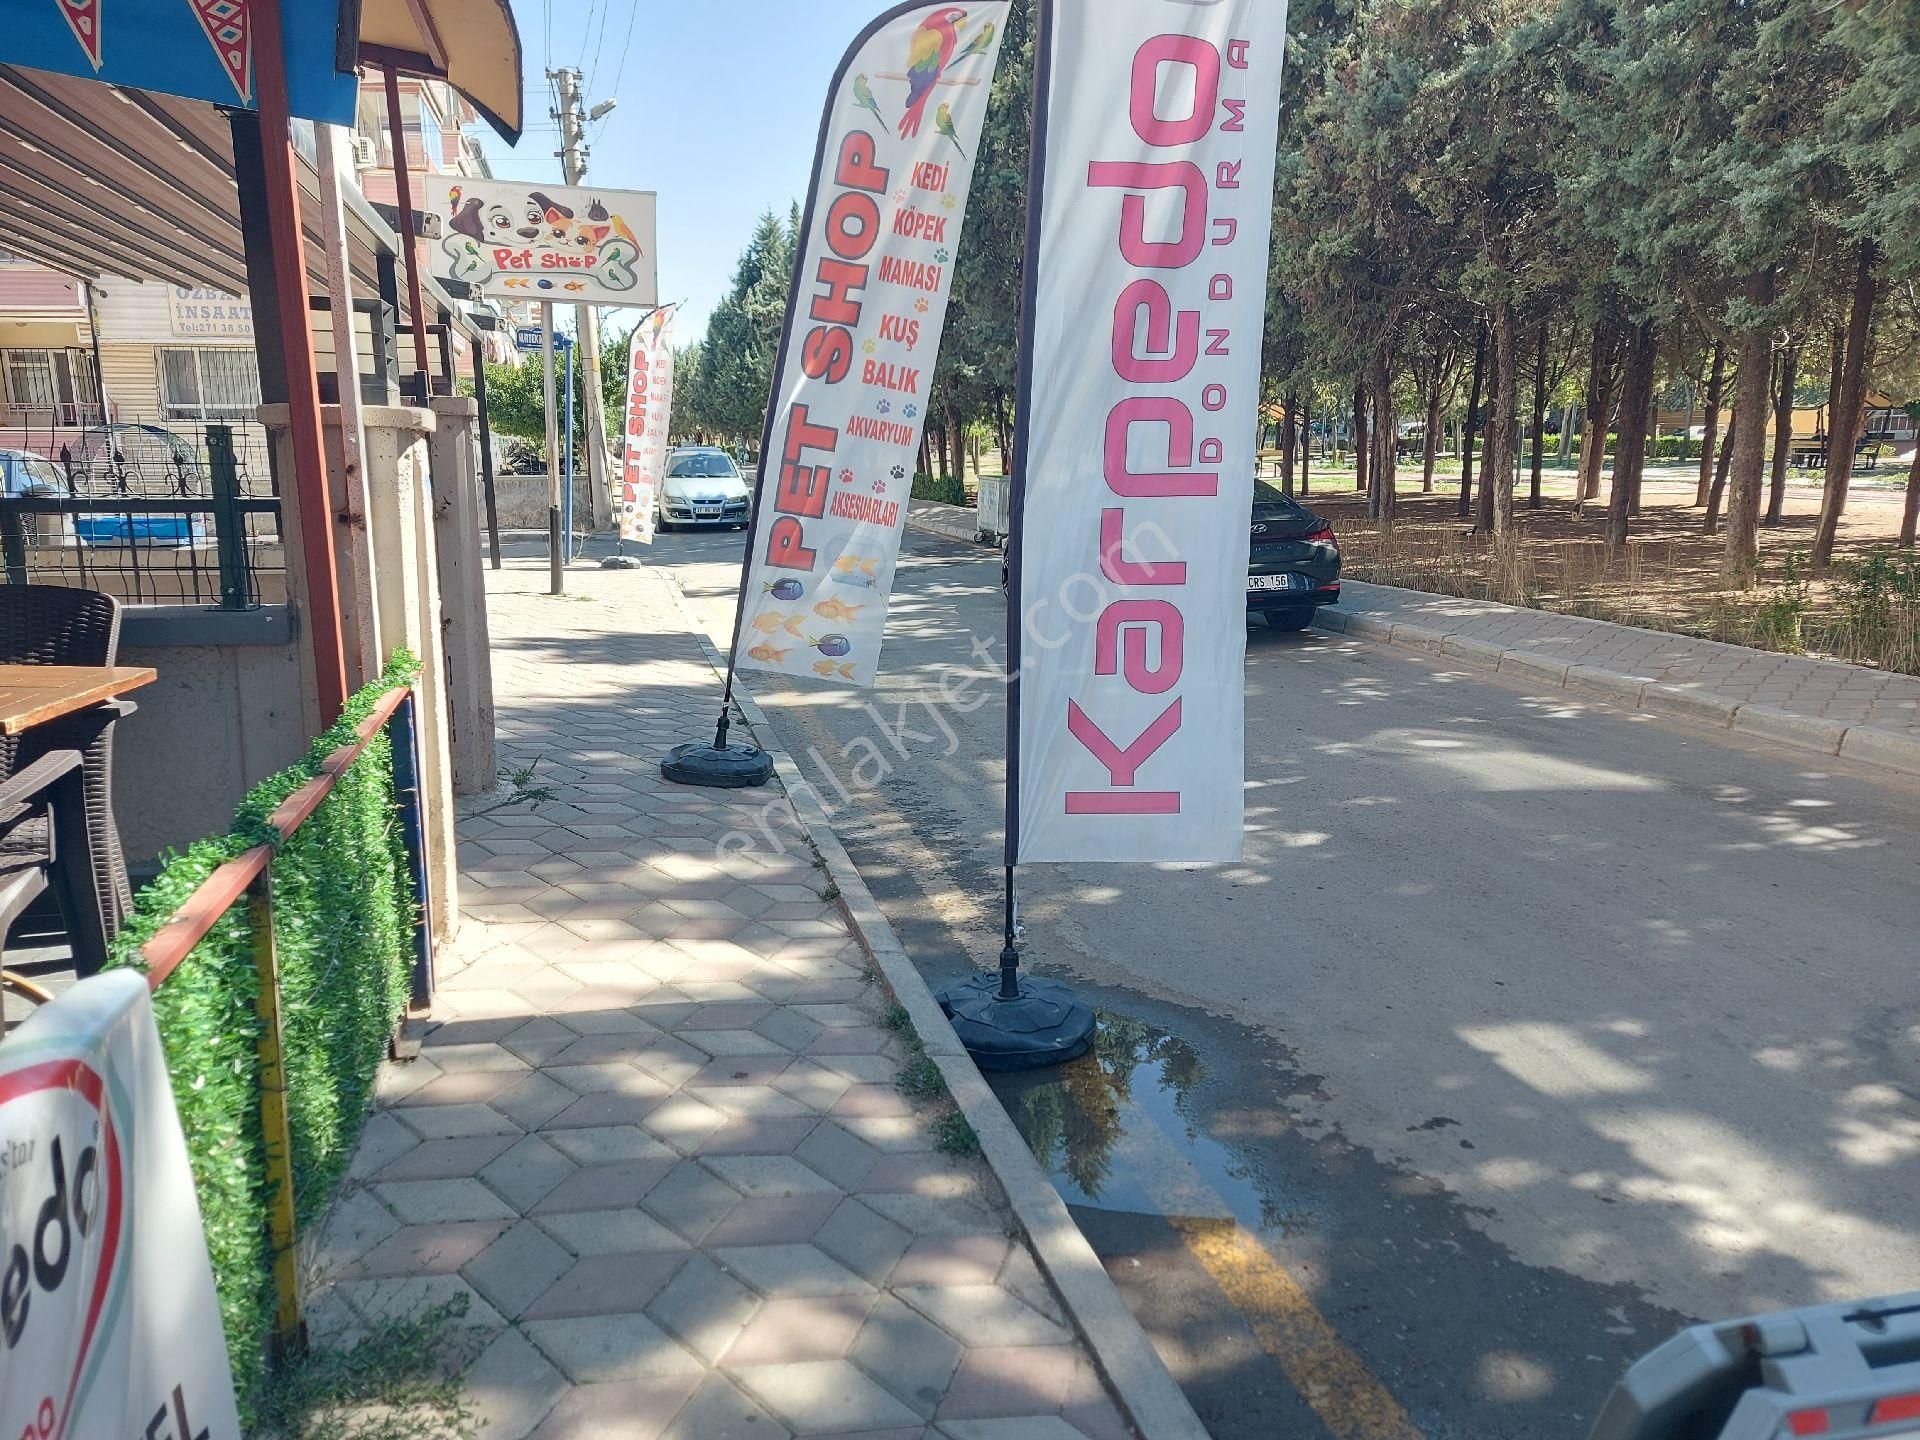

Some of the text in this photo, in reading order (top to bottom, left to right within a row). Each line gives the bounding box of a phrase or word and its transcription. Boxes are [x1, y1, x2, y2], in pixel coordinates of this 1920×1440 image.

[910, 161, 949, 193] KEDİ
[893, 206, 947, 243] KÖPEK
[493, 248, 533, 270] Pet
[1199, 39, 1249, 463] DONDURMA
[879, 255, 942, 292] MAMASI
[238, 325, 250, 333] 50
[879, 313, 920, 352] KUŞ
[765, 130, 890, 572] PET SHOP
[628, 350, 650, 437] SHOP
[861, 360, 920, 394] BALIK
[846, 415, 913, 447] AKVARYUM
[1065, 34, 1220, 814] Karpedo
[623, 444, 641, 503] PET
[829, 491, 899, 528] AKSESUARLARI
[1270, 575, 1287, 587] 156
